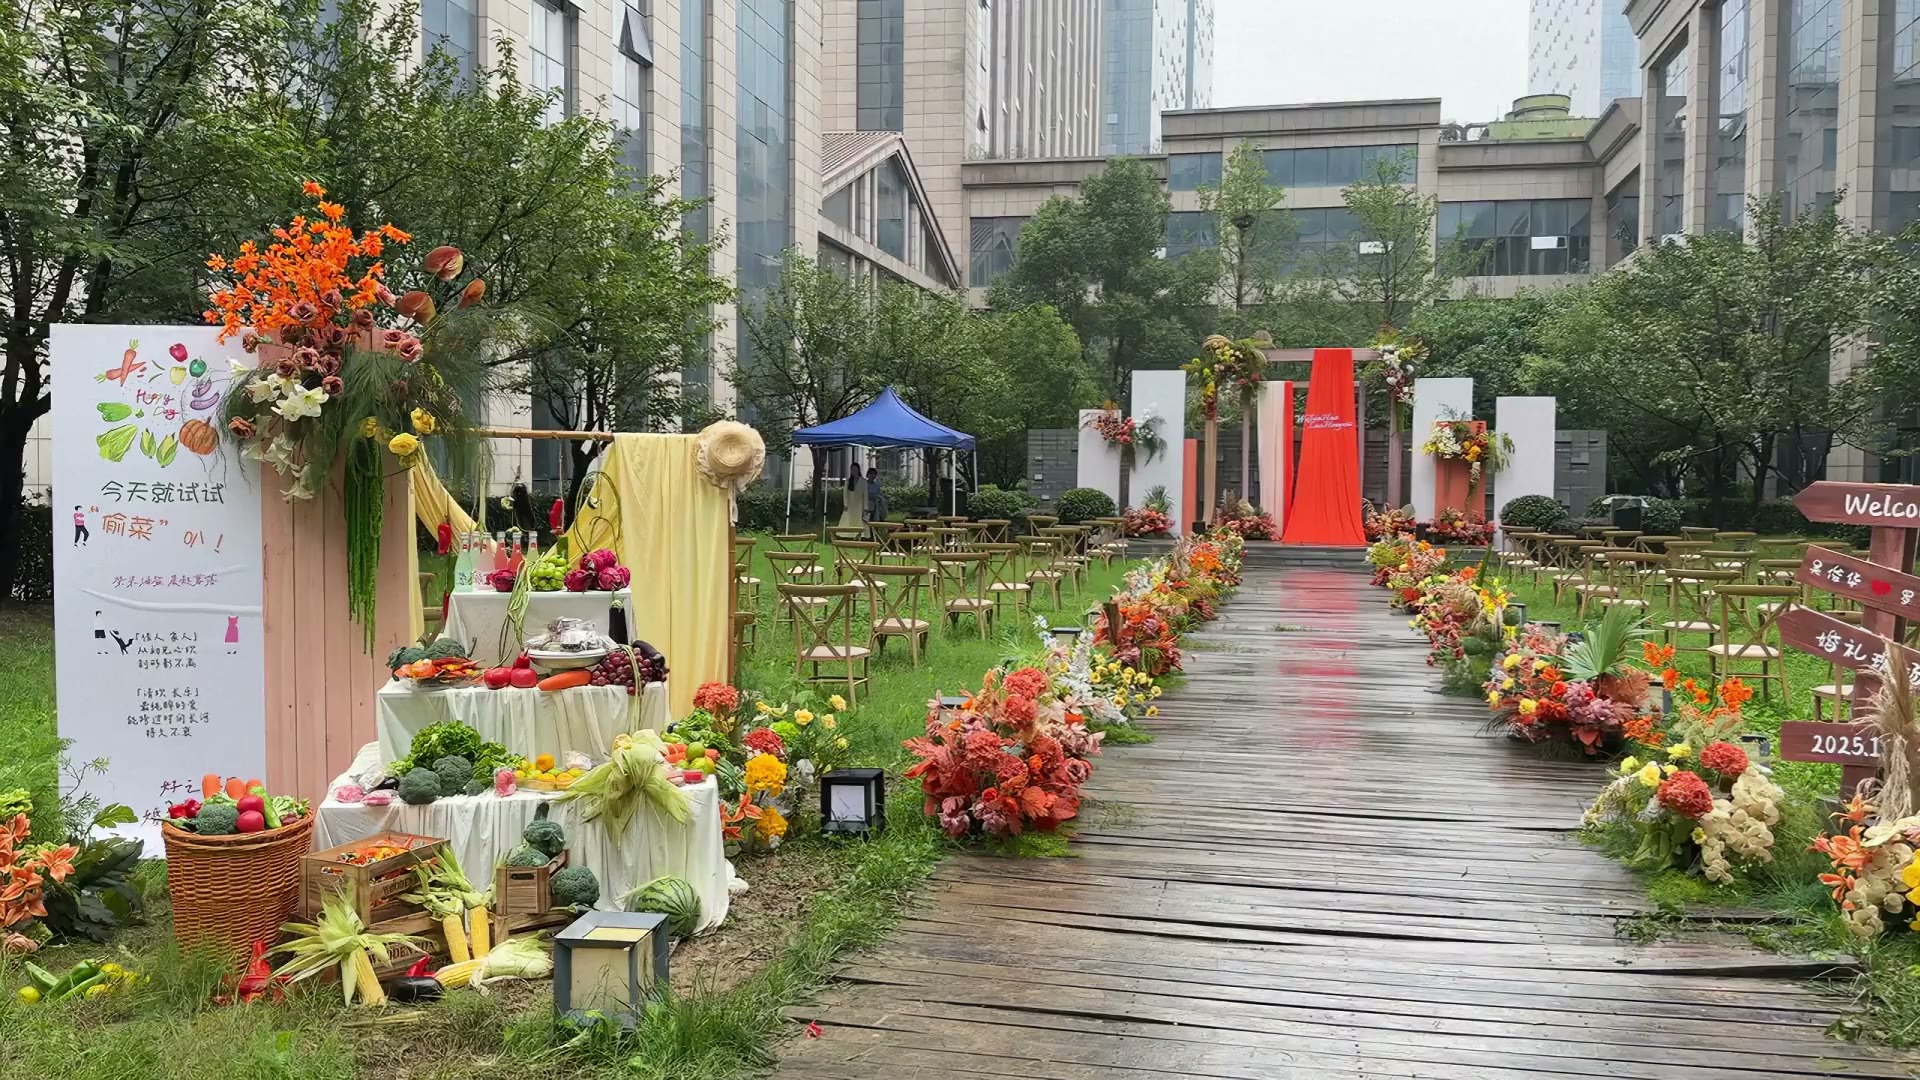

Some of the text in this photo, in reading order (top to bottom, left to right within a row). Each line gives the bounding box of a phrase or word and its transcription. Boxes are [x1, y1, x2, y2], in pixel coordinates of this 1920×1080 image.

[153, 406, 180, 421] Day
[101, 480, 226, 504] 今天就试试
[1844, 492, 1920, 519] Welco
